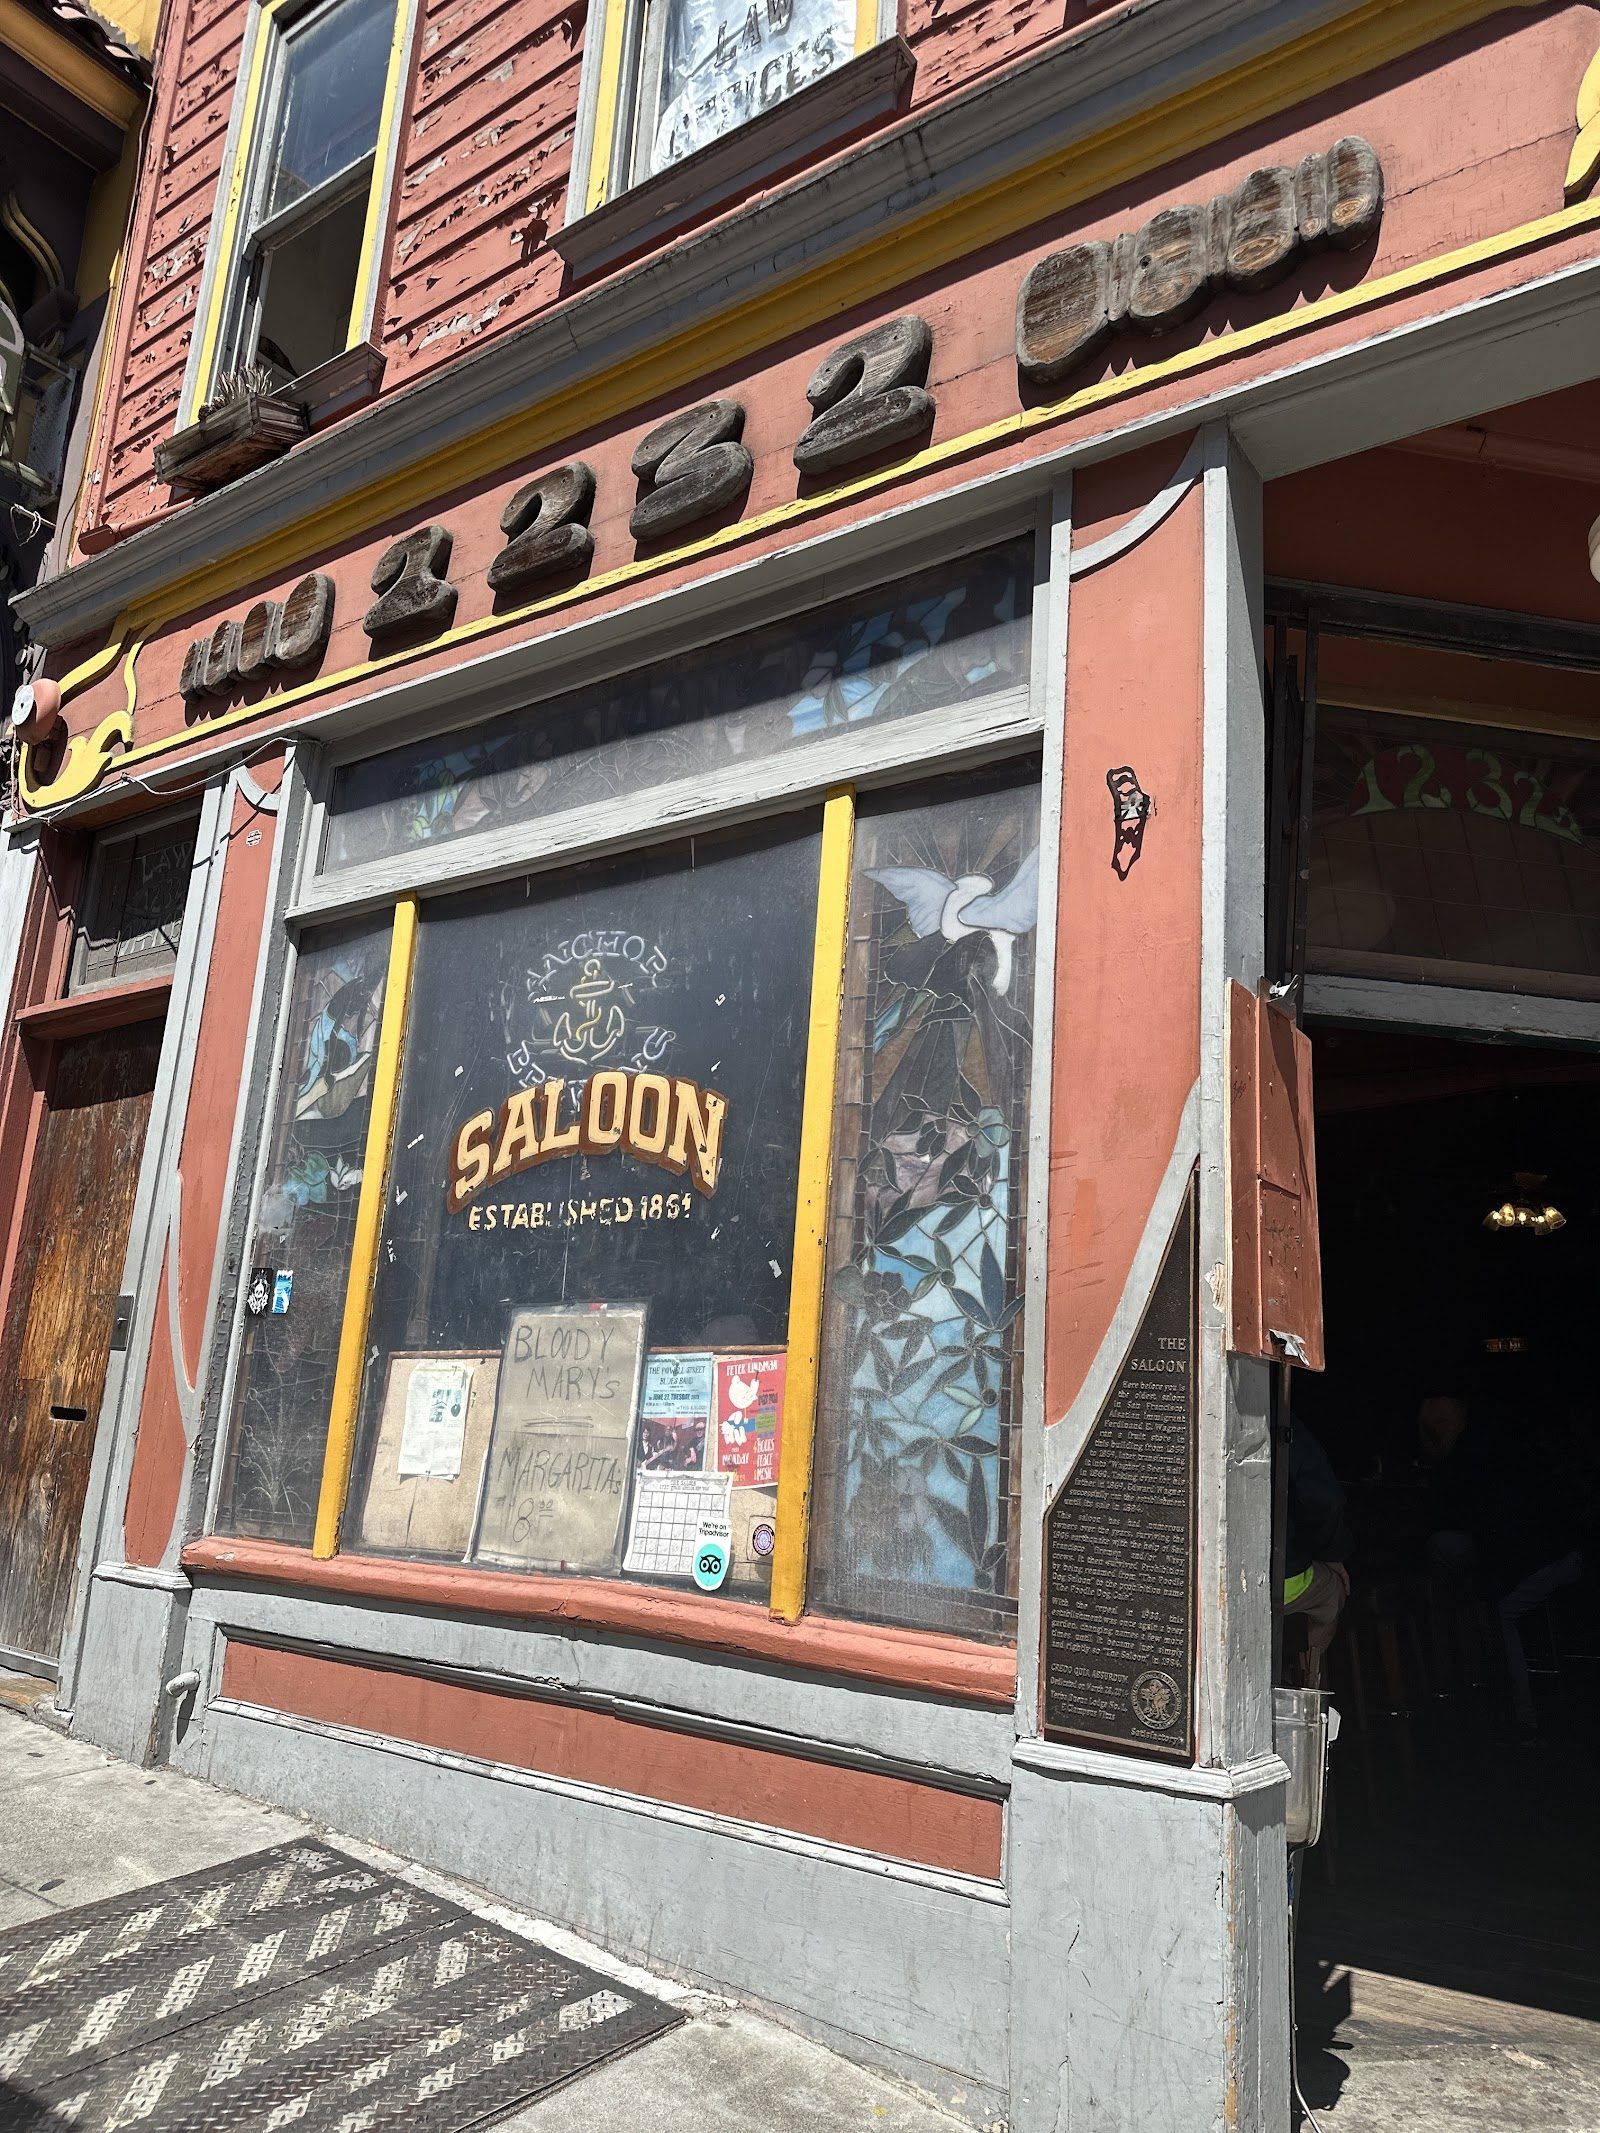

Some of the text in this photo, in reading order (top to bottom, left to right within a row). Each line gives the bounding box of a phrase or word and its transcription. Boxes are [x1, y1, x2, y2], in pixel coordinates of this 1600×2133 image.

[714, 0, 794, 68] LAW
[1350, 743, 1585, 845] 1232
[448, 1068, 729, 1210] SALOON
[514, 1325, 615, 1363] BLOODY
[1157, 1336, 1186, 1350] THE
[726, 1364, 746, 1377] PETER
[1131, 1357, 1186, 1373] SALOON
[699, 1527, 730, 1538] Tripadvisor
[702, 1521, 718, 1529] We're
